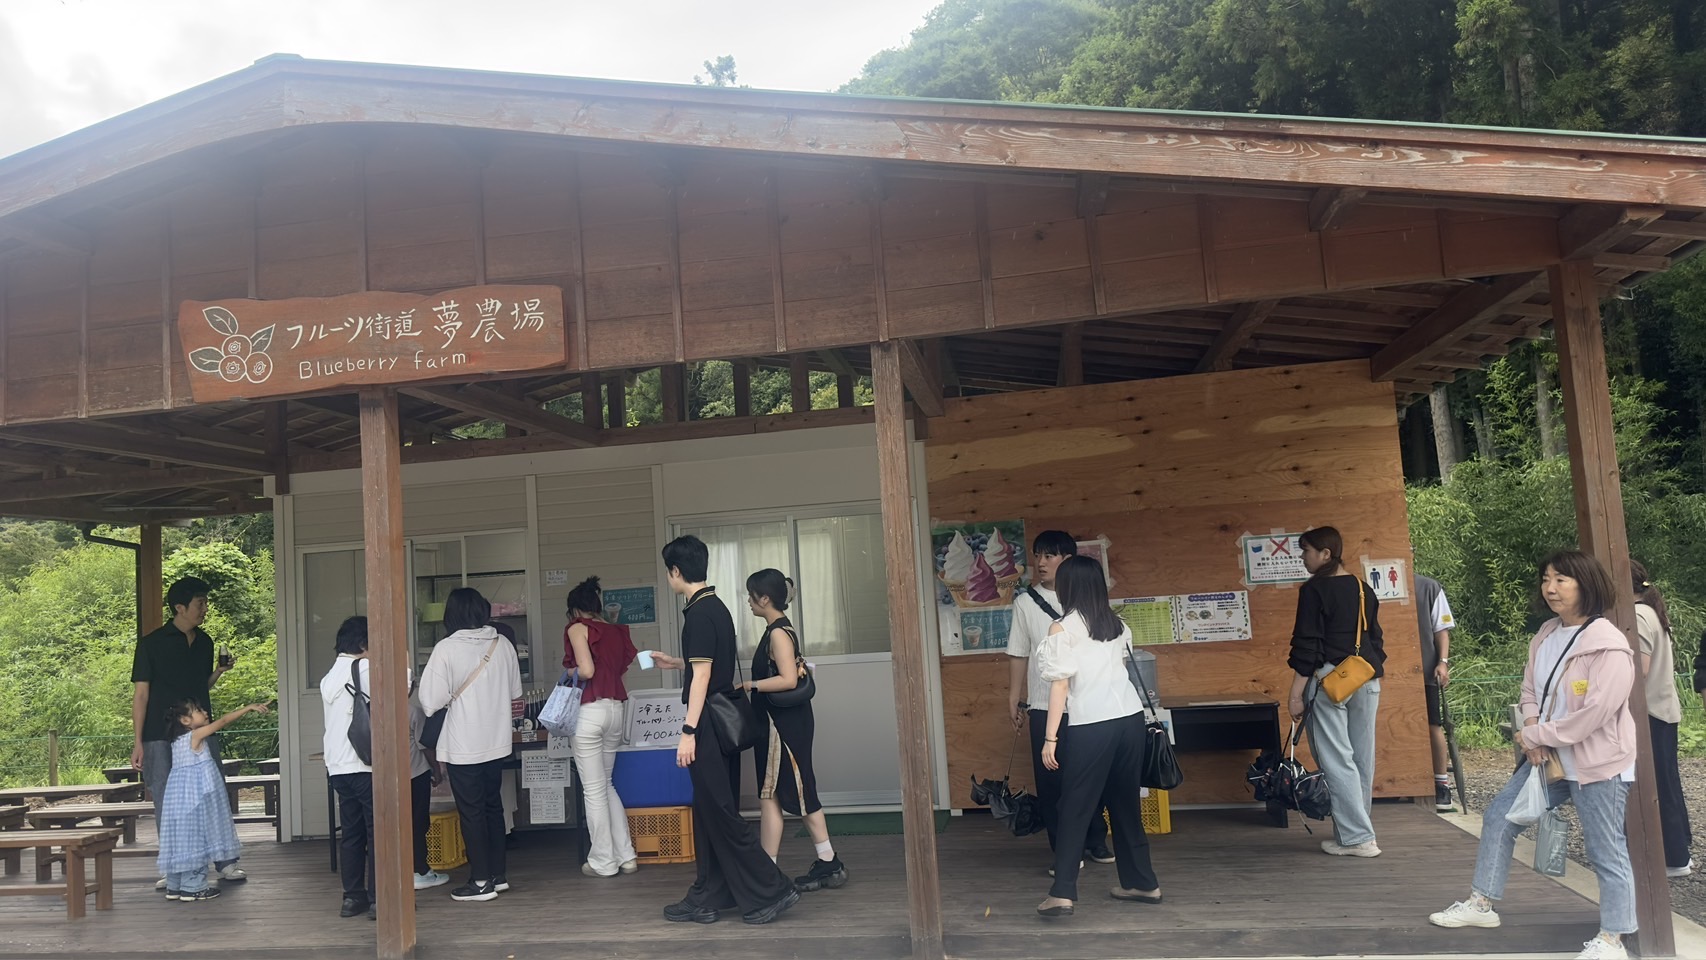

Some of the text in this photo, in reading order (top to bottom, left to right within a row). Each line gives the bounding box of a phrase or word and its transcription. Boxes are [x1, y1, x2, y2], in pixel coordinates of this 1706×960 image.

[285, 297, 546, 350] フルーツ街道 夢農場
[298, 349, 467, 380] Blueberry farm
[638, 703, 672, 716] 冷えた
